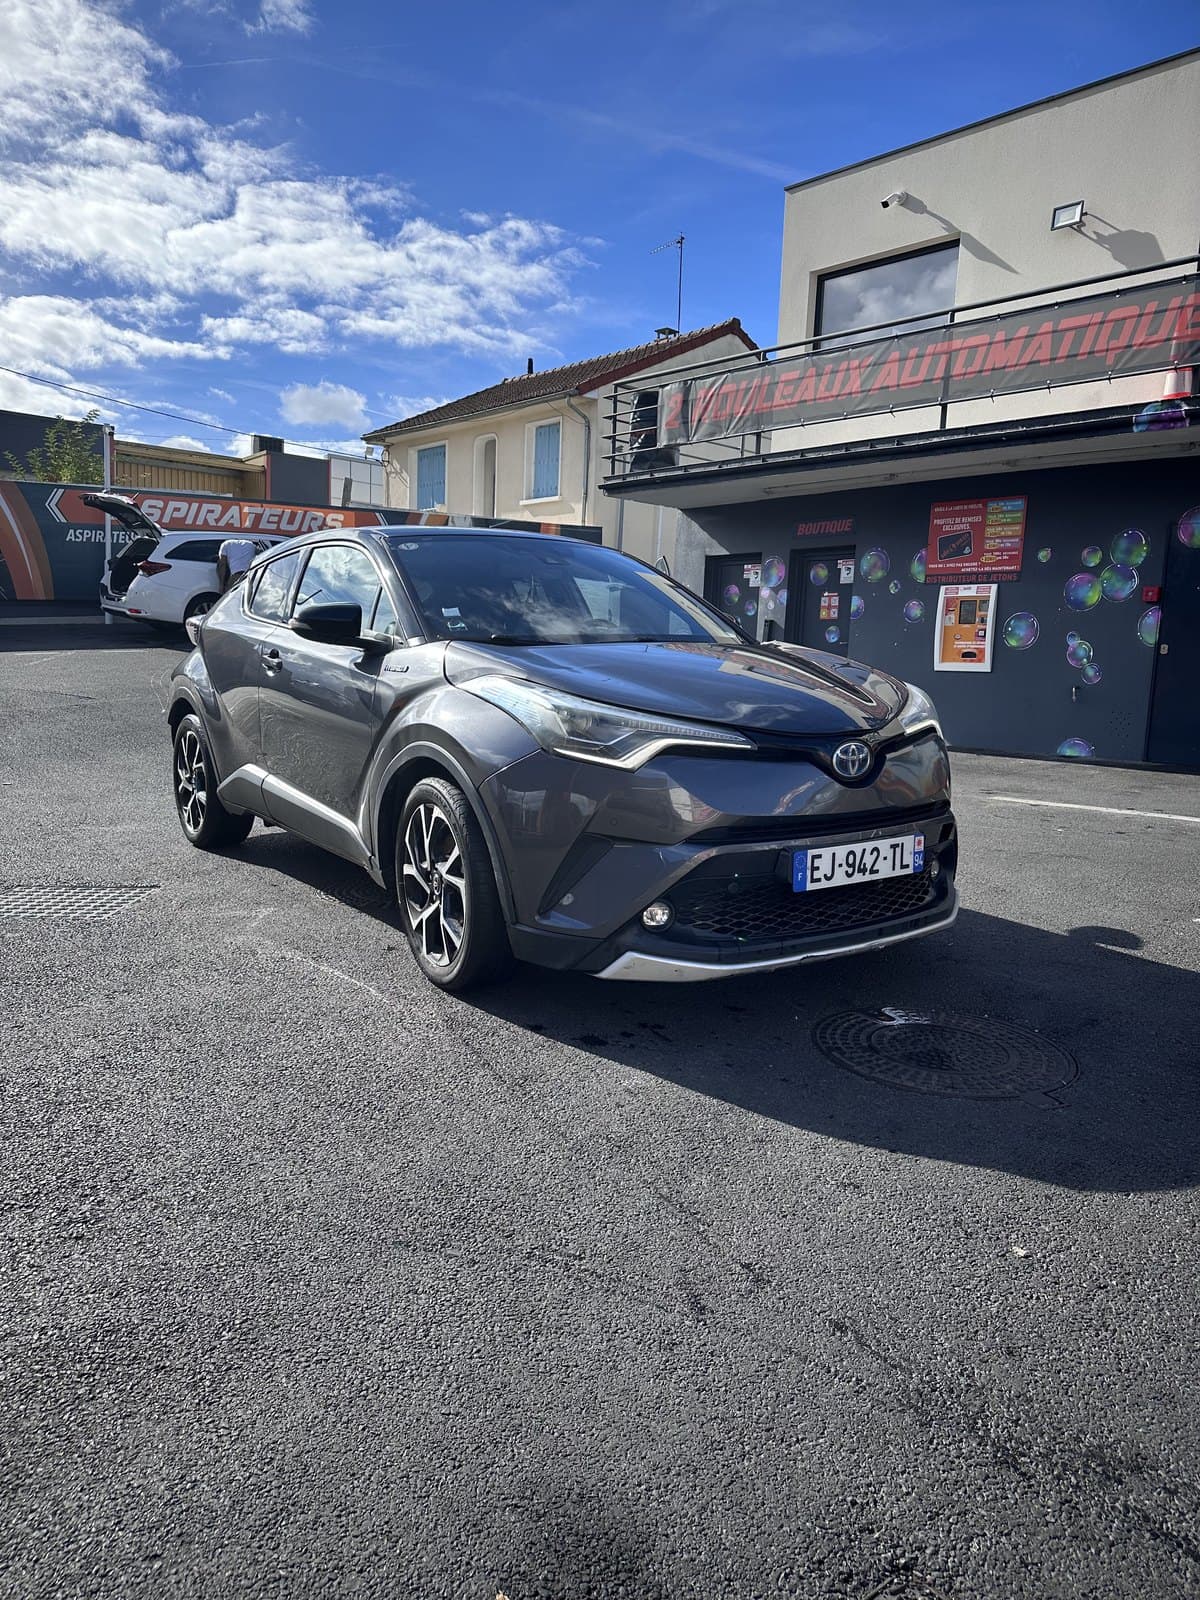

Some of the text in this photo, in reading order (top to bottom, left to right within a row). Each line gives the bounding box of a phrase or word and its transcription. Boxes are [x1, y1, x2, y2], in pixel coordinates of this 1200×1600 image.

[665, 392, 684, 430] 2
[140, 499, 344, 532] SPIRATEURS
[796, 519, 853, 536] BOUTIQUE
[66, 529, 135, 544] ASPIRTEU
[810, 842, 910, 884] EJ-942-TL
[914, 854, 923, 866] 94
